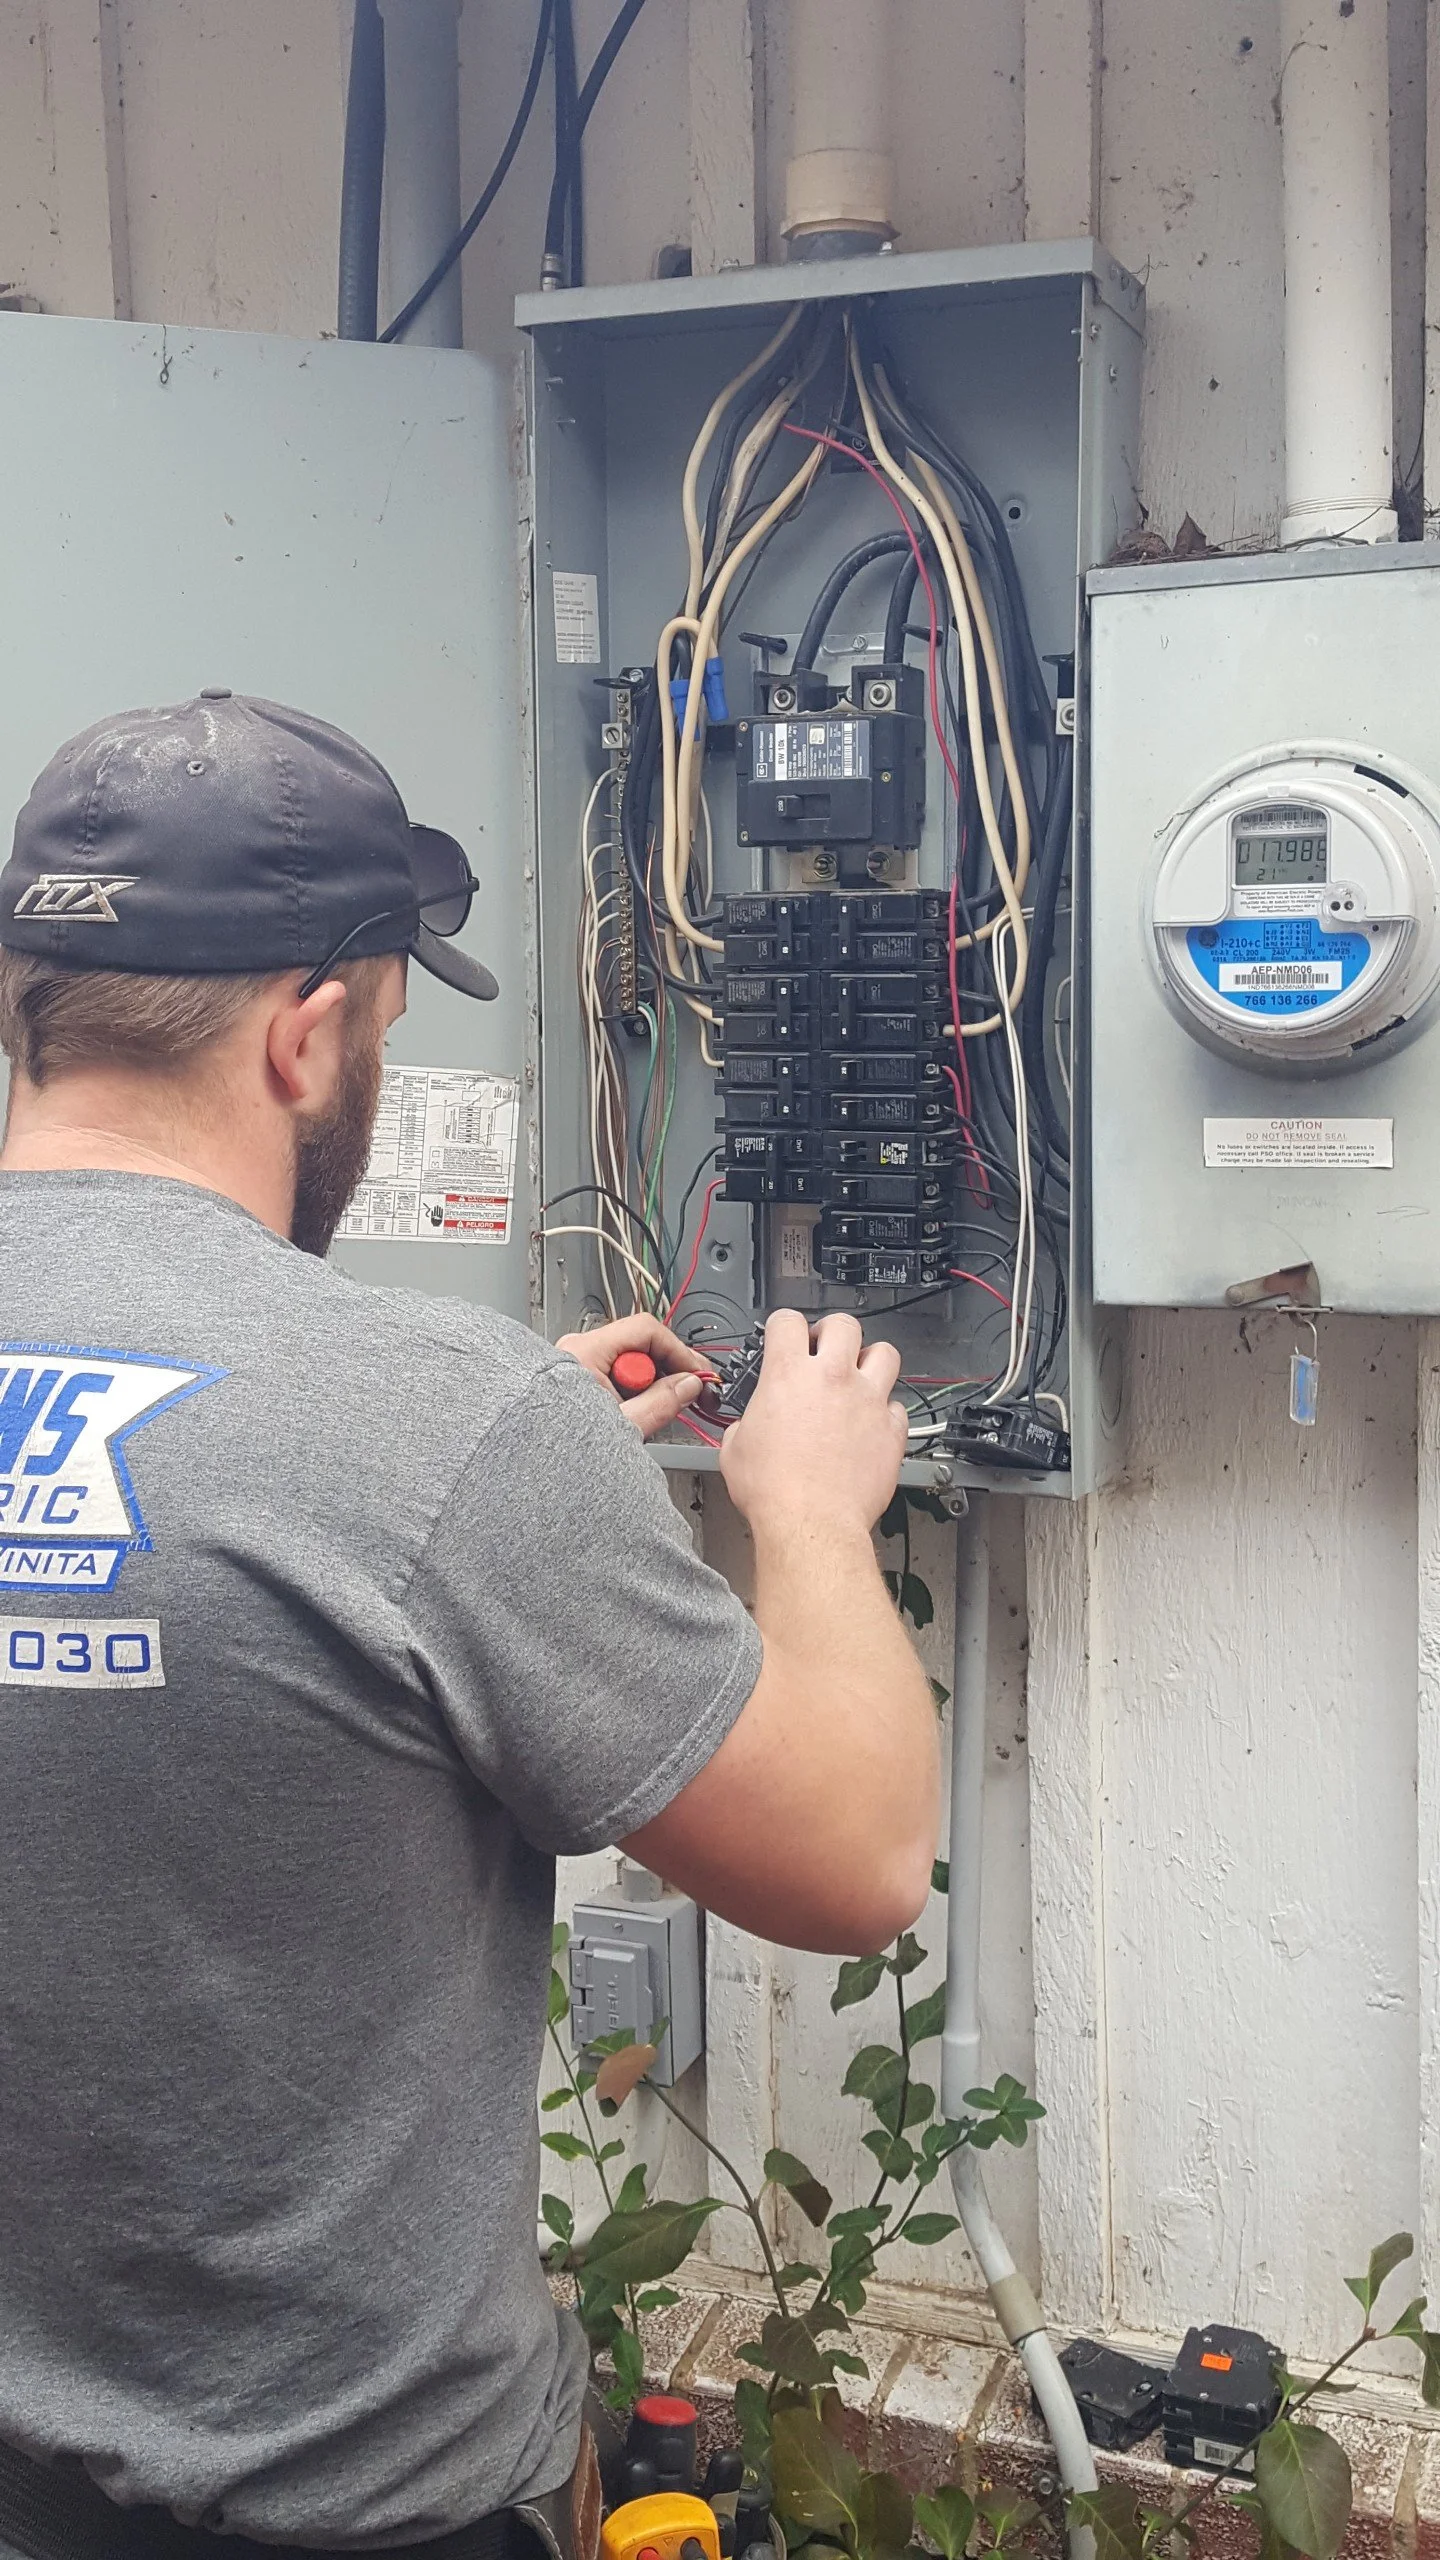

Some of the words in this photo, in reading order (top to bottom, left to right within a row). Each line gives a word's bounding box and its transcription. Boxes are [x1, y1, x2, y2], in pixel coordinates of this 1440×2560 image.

[777, 753, 785, 765] BW
[1256, 868, 1276, 881] 21
[1251, 965, 1312, 975] AEP-NMD06
[1245, 996, 1266, 1005] 766
[1271, 996, 1292, 1005] 136
[1296, 995, 1318, 1005] 266
[1270, 1121, 1323, 1130] CAUTION
[1284, 1132, 1322, 1140] REMOVE
[768, 1181, 773, 1190] 20
[0, 1547, 96, 1575] INITA
